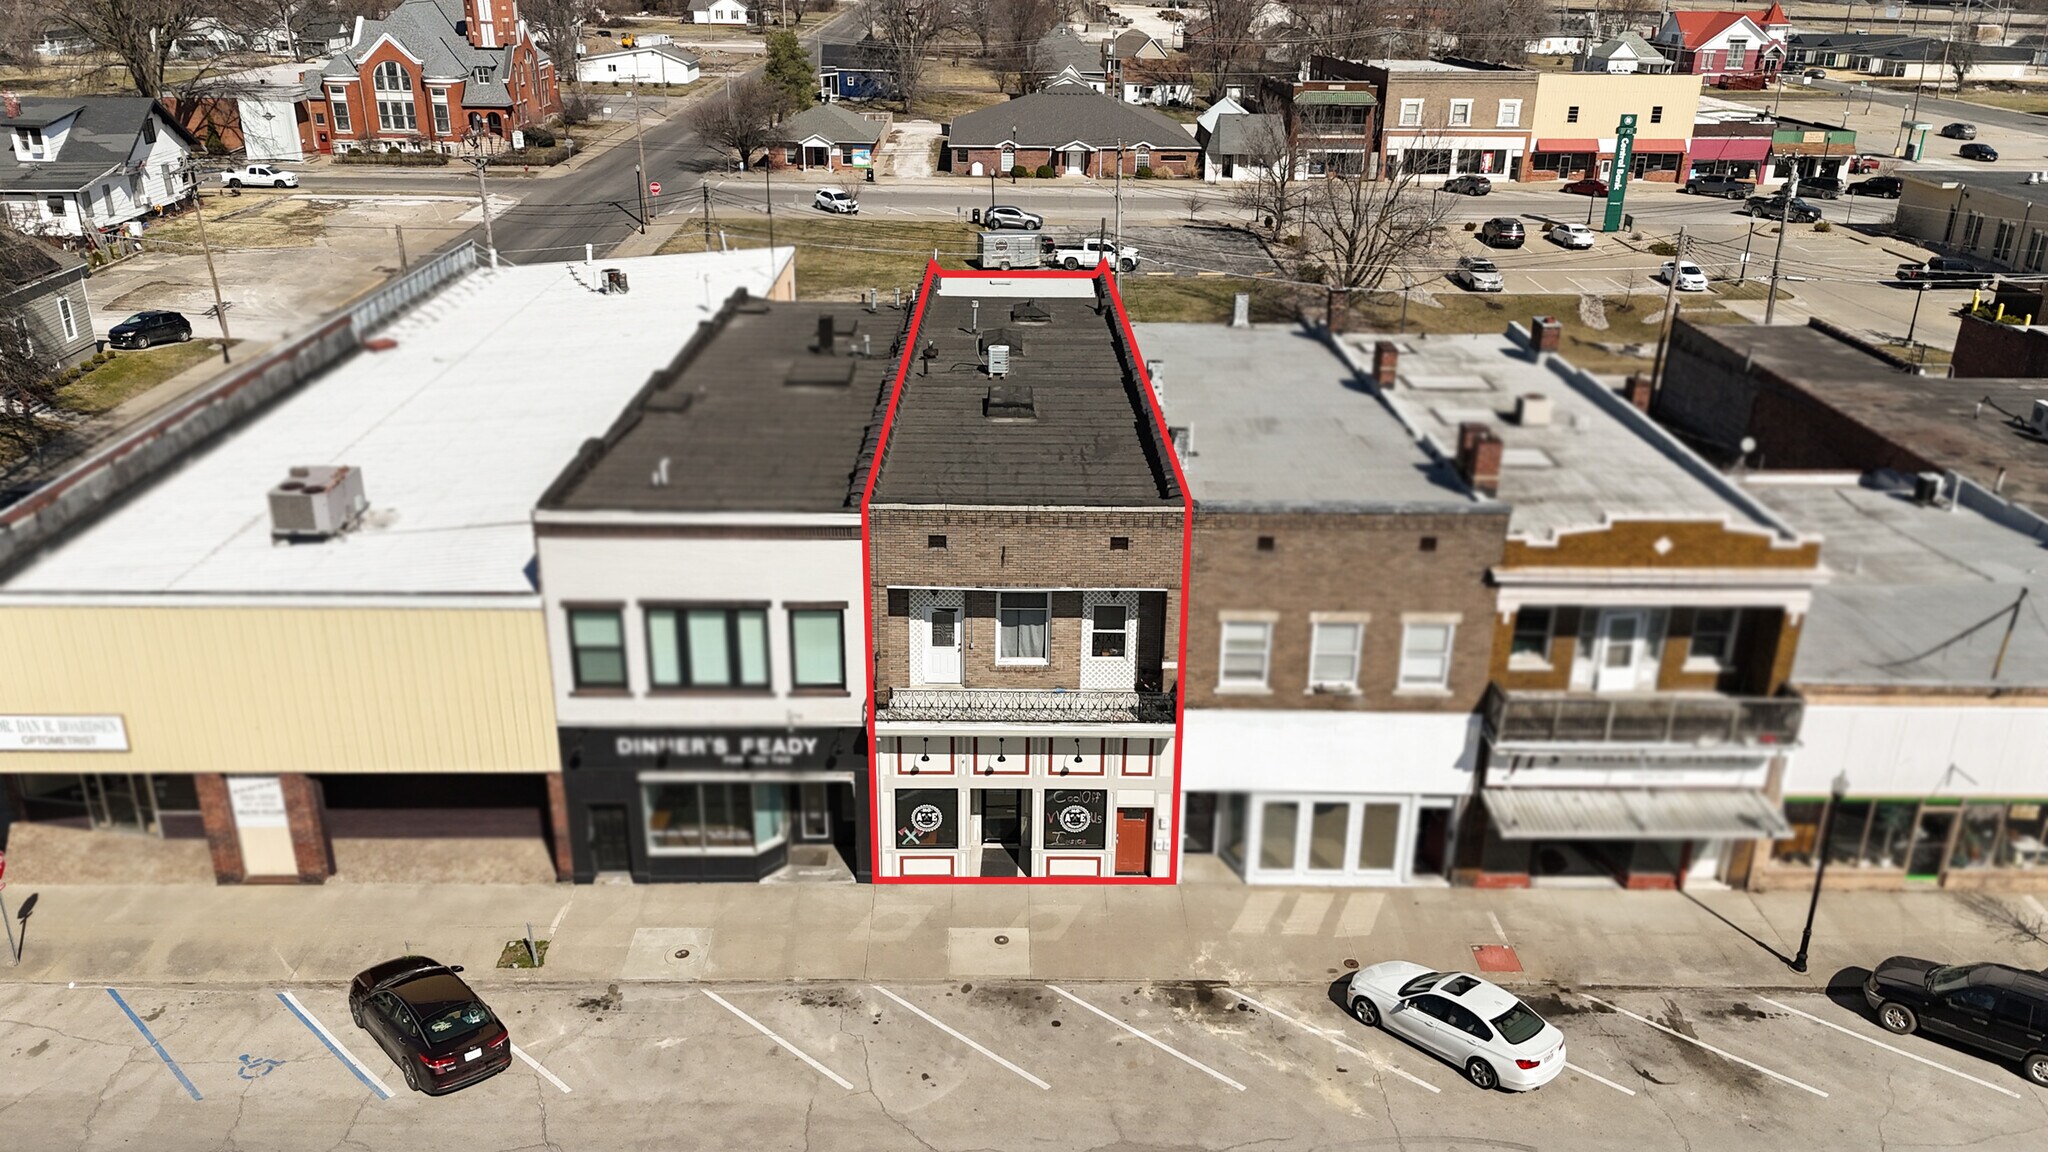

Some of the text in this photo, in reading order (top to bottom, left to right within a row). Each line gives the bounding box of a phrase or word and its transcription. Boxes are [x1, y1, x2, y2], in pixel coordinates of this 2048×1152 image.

[1617, 137, 1629, 168] Central
[1613, 168, 1625, 191] Bank
[21, 735, 97, 746] OPTOMETRIST
